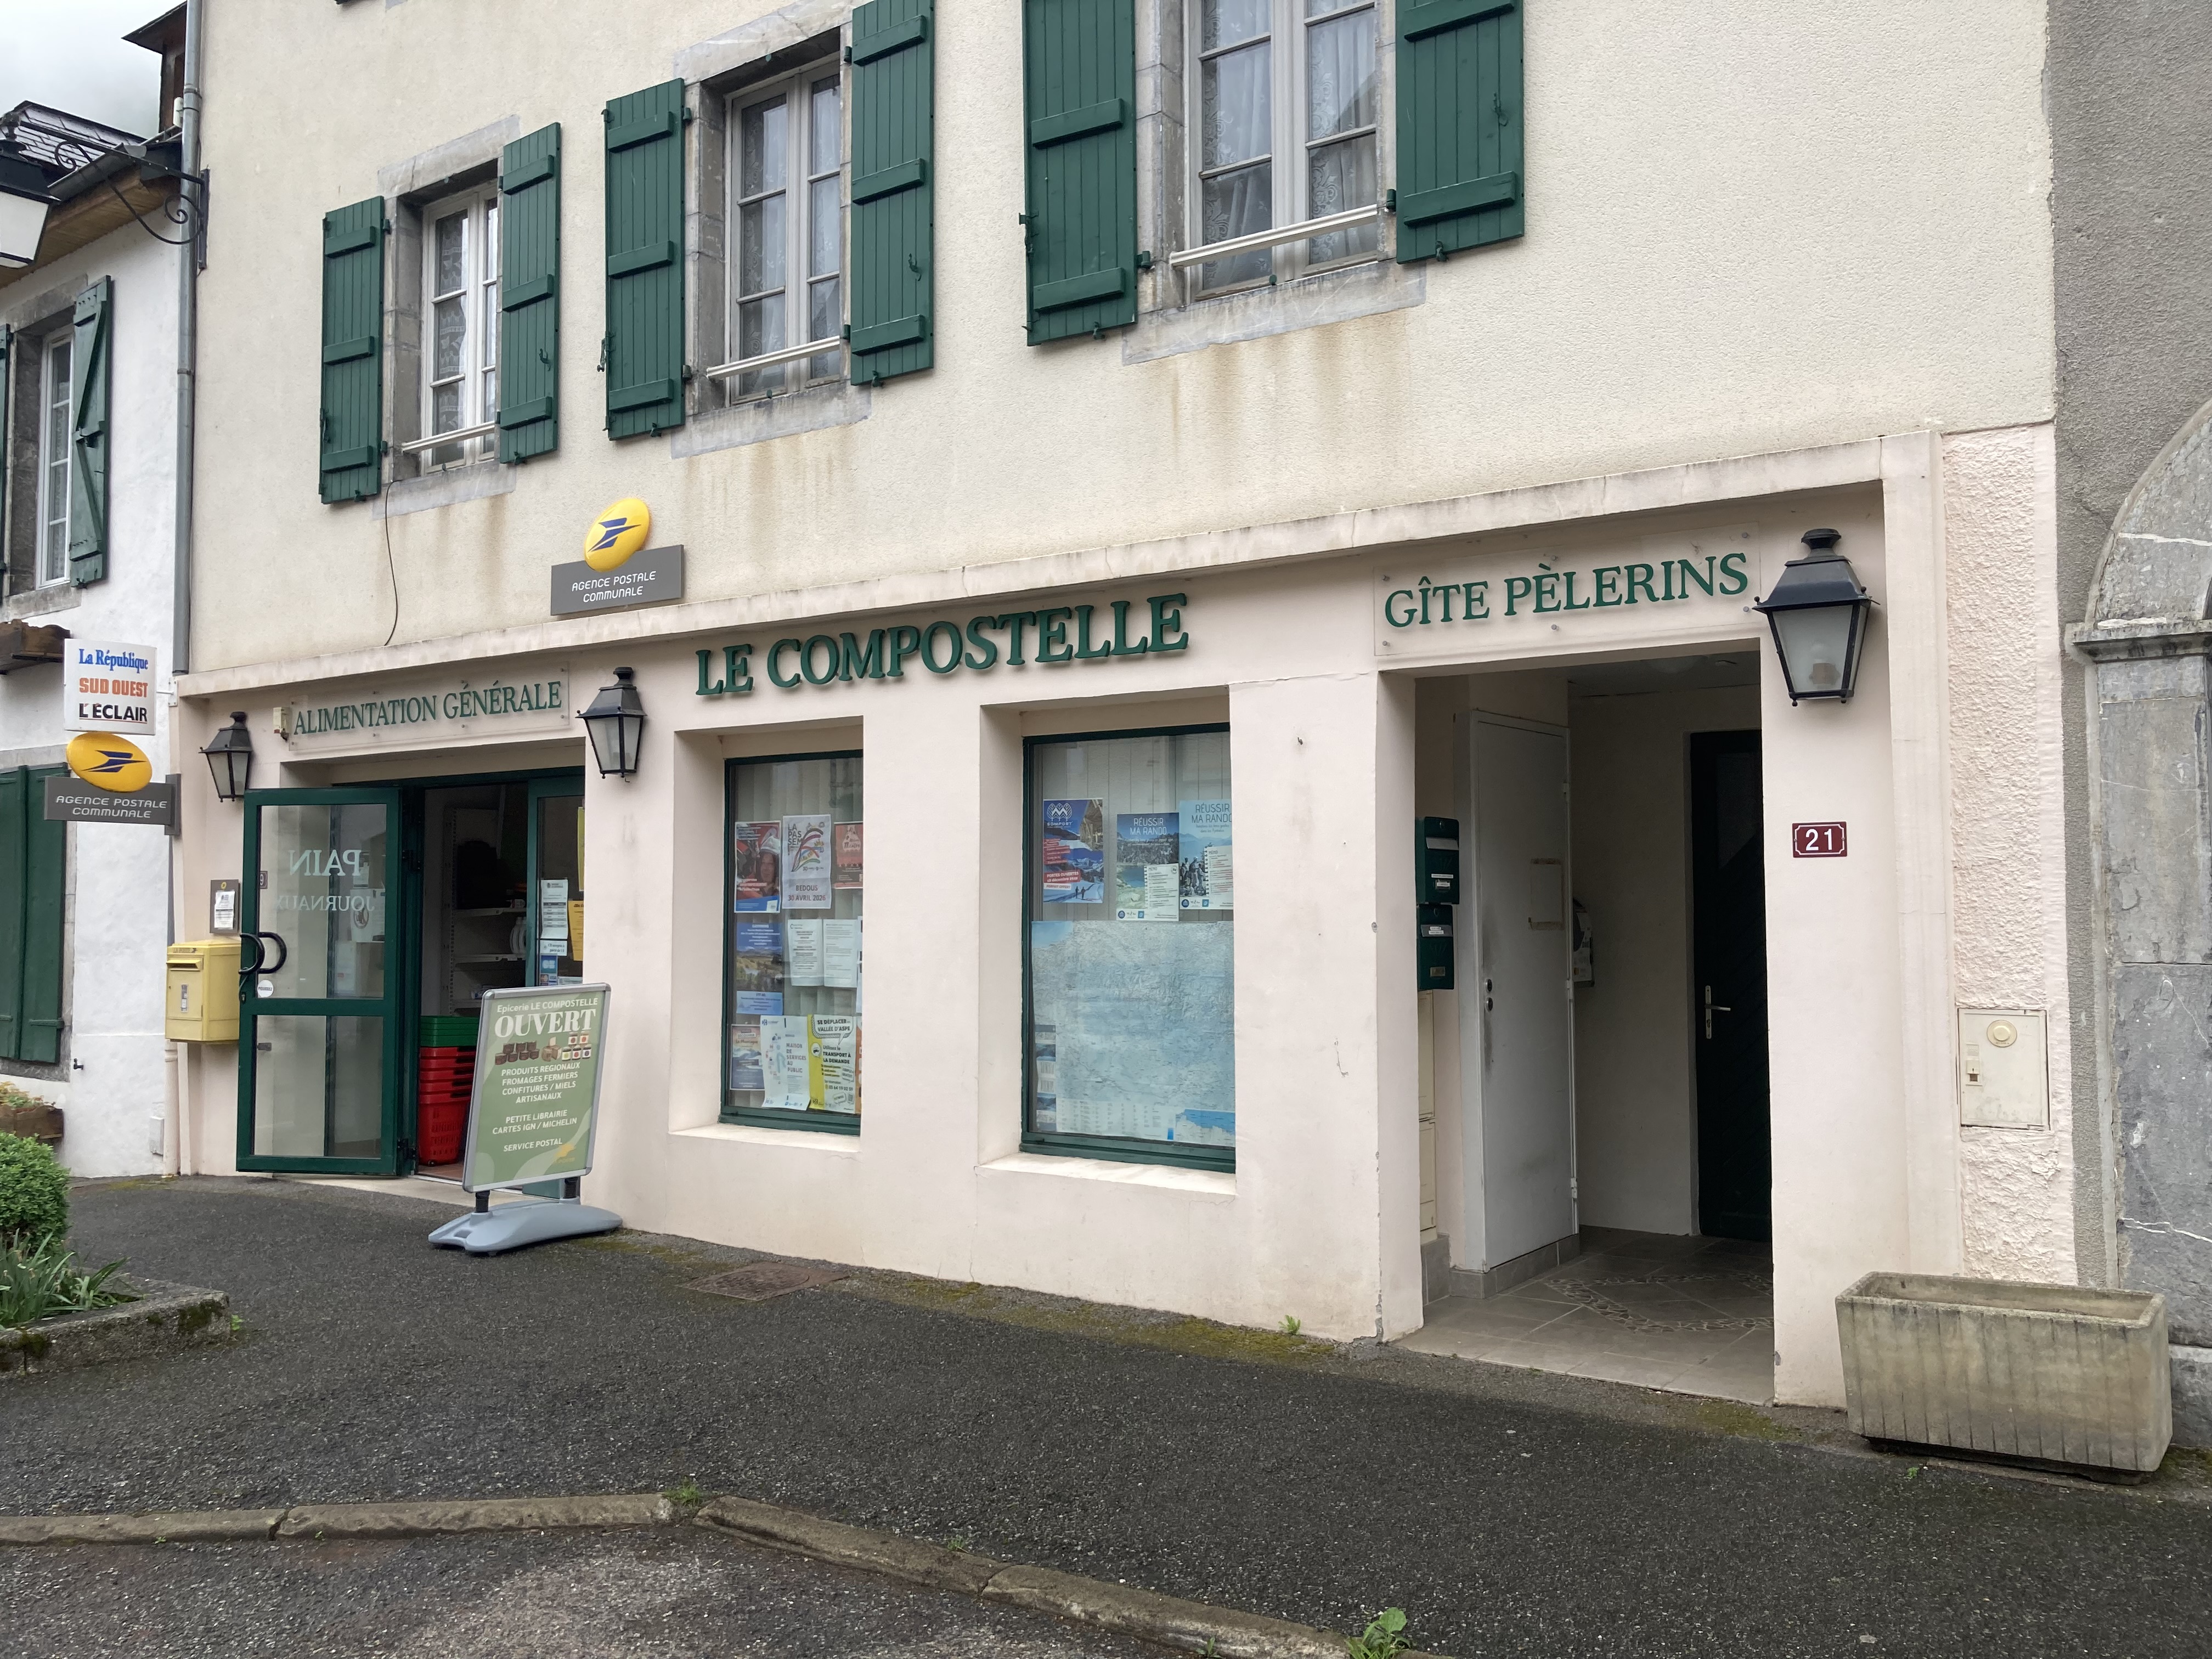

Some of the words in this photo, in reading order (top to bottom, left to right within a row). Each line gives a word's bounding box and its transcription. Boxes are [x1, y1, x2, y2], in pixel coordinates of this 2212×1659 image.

[572, 577, 611, 592] AGENCE
[613, 571, 656, 586] POSTALE
[583, 585, 644, 603] COMMUNALE
[1385, 576, 1490, 628] GÎTE
[1504, 552, 1749, 616] PÈLERINS
[695, 644, 755, 696] LE
[768, 592, 1189, 688] COMPOSTELLE
[79, 648, 93, 664] La
[95, 649, 148, 674] République
[79, 678, 110, 694] SUD
[112, 680, 148, 698] OUEST
[294, 695, 438, 735] ALIMENTATION
[443, 680, 563, 720] GÉNÉRALE
[56, 795, 110, 806] AGENCE
[114, 798, 168, 809] POSTALE
[1195, 803, 1229, 813] RÉUSSIR
[72, 807, 152, 819] COMMUNALE
[1192, 814, 1204, 823] MA
[1133, 816, 1164, 826] RÉUSSIR
[1143, 827, 1167, 835] RANDO
[1805, 828, 1832, 851] 21
[497, 1003, 529, 1014] Epicerie
[531, 1002, 541, 1010] LE
[542, 997, 599, 1009] COMPOSTELLE
[495, 1009, 596, 1037] OUVERT
[501, 1066, 538, 1076] PRODUITS
[540, 1062, 580, 1073] REGIONAUX
[502, 1075, 543, 1086] FROMAGES
[544, 1071, 578, 1081] FERMIERS
[502, 1084, 549, 1096] CONFITURES
[555, 1081, 576, 1090] MIELS
[516, 1092, 562, 1103] ARTISANAUX
[506, 1114, 532, 1124] PETITE
[533, 1109, 568, 1120] LIBRAIRIE
[493, 1125, 521, 1135] CARTES
[523, 1122, 536, 1131] IGN
[543, 1117, 577, 1128] MICHELIN
[503, 1142, 535, 1152] SERVICE
[535, 1138, 563, 1148] POSTAL
